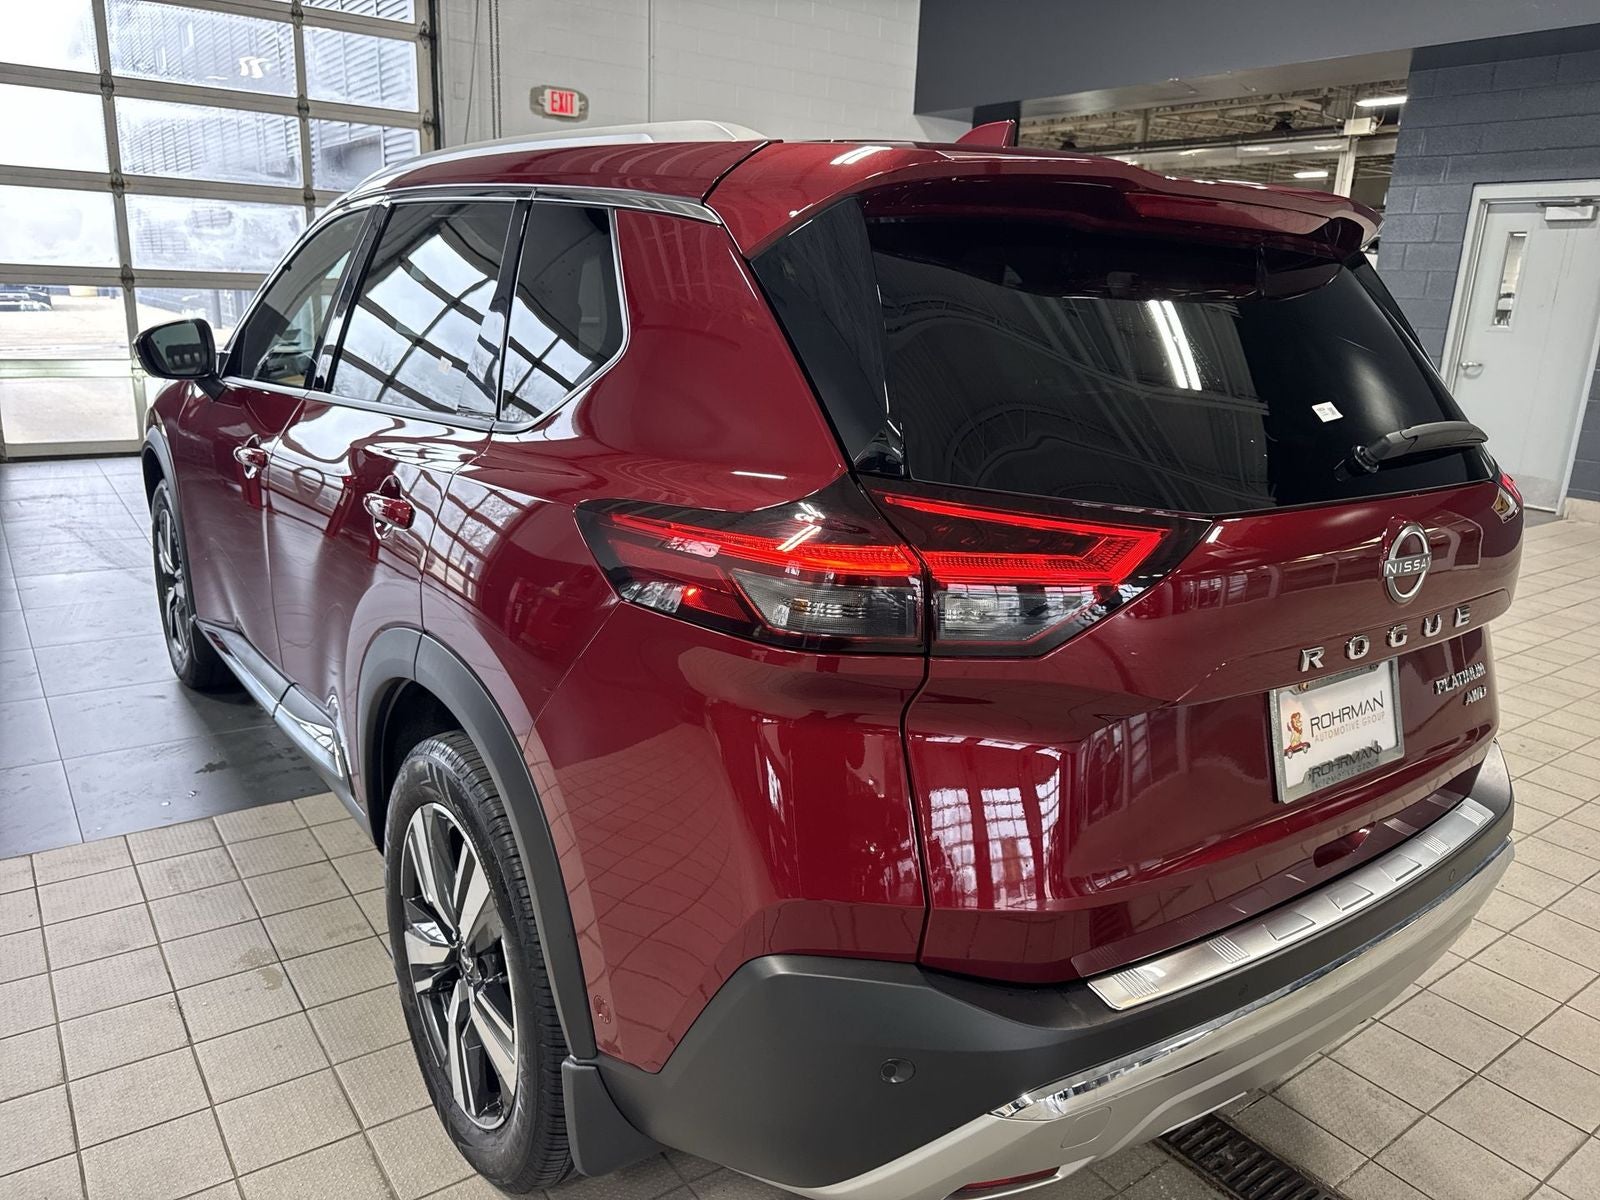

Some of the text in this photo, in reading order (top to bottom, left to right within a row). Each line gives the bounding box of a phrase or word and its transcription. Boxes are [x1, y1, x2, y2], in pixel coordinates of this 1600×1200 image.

[551, 91, 575, 114] EXIT
[1386, 557, 1430, 575] NISSA
[1300, 604, 1471, 672] ROGUE
[1434, 662, 1486, 695] PLATINUM
[1464, 686, 1487, 706] AWD
[1310, 690, 1384, 738] ROHRMAN
[1315, 711, 1385, 743] AUTOMOTIVE GROUP
[1309, 740, 1382, 783] ROHRMAN
